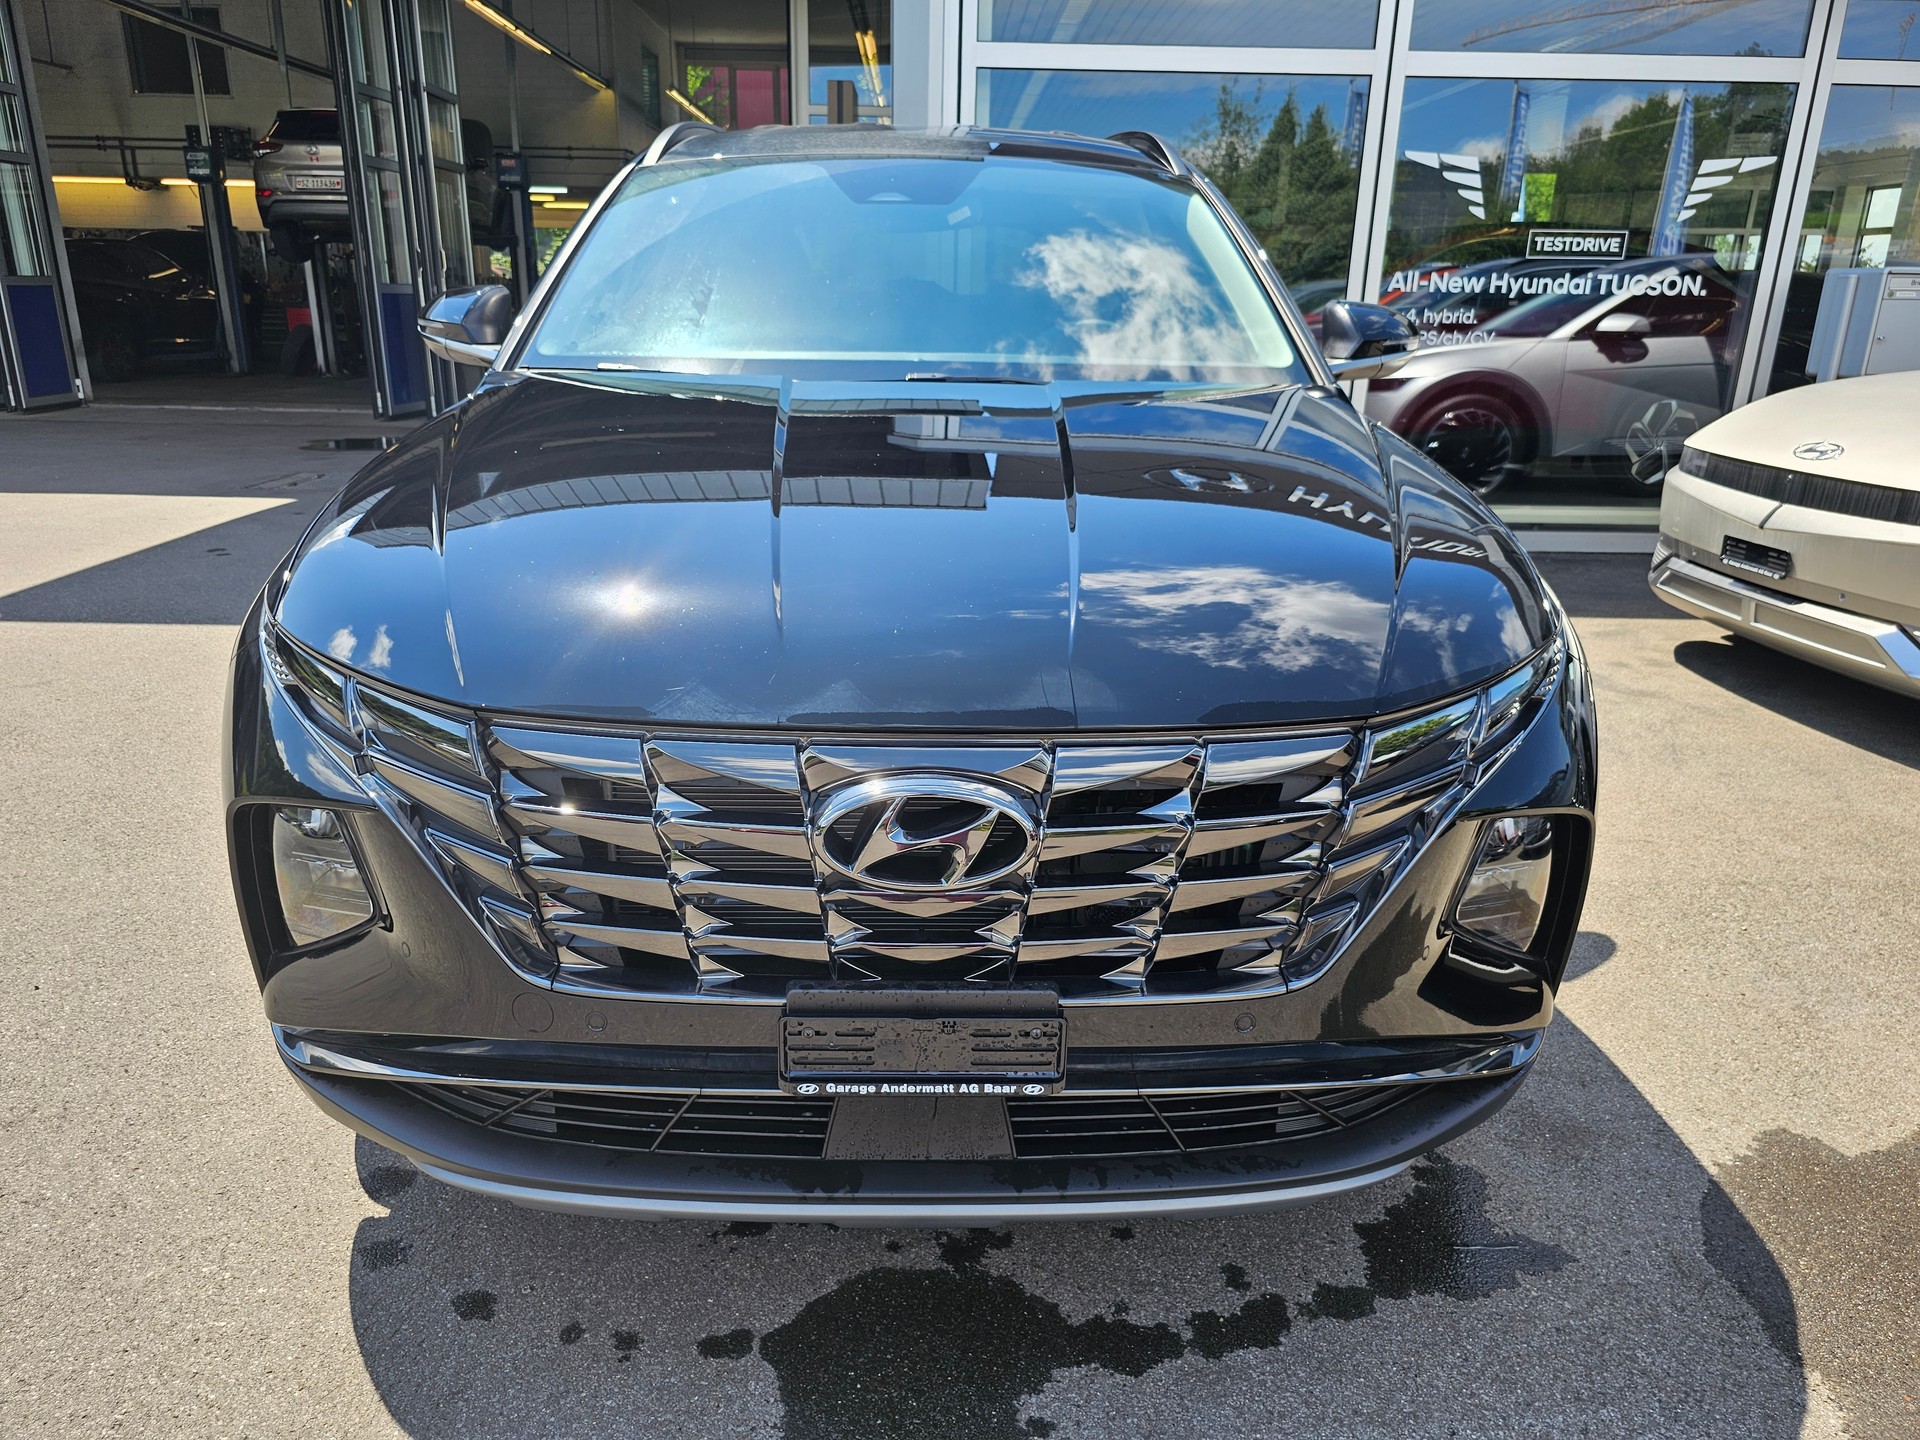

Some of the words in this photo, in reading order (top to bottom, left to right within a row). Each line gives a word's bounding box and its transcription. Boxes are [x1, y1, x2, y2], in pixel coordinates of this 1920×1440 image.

[1534, 236, 1621, 252] TESTDRIVE
[1386, 270, 1486, 294] All-New
[1489, 272, 1594, 299] Hyundai
[1597, 274, 1707, 298] TUCSON.
[1423, 308, 1478, 327] hybrid.
[825, 1082, 876, 1095] Garage
[881, 1083, 955, 1094] Andermatt
[959, 1083, 979, 1094] AG
[984, 1083, 1017, 1094] Baar
